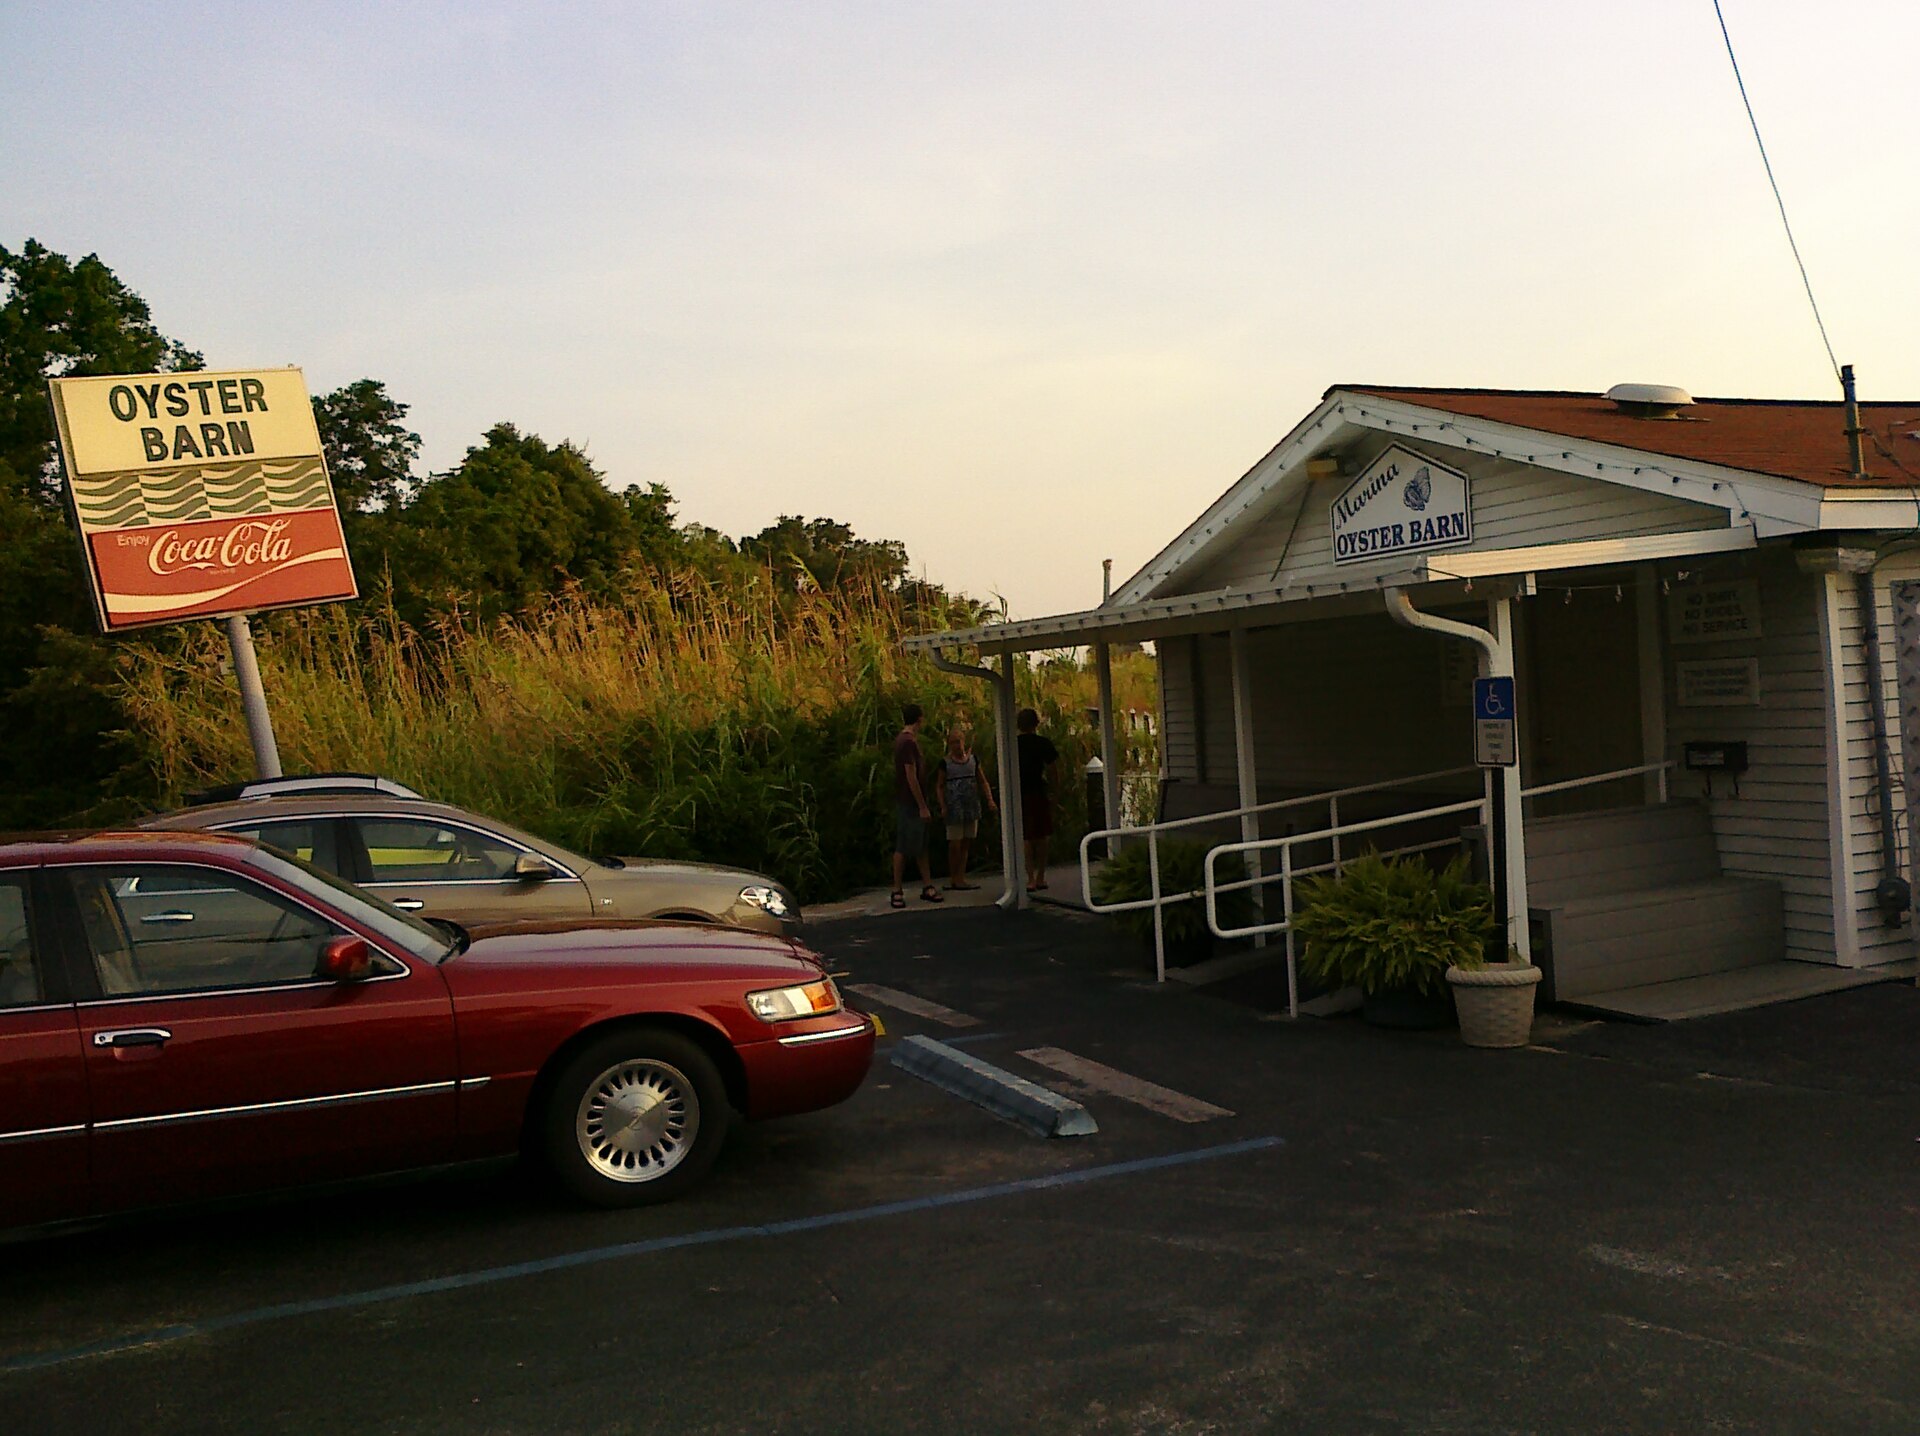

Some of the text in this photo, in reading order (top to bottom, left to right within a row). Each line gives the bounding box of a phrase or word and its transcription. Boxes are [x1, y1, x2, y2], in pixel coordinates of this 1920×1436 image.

[109, 378, 268, 422] OYSTER
[140, 420, 255, 462] BARN
[1336, 463, 1400, 530] Marina
[116, 519, 292, 575] Enjoy Coca-Cola
[1336, 512, 1465, 556] OYSTER BARN
[1702, 617, 1748, 633] SERVICE
